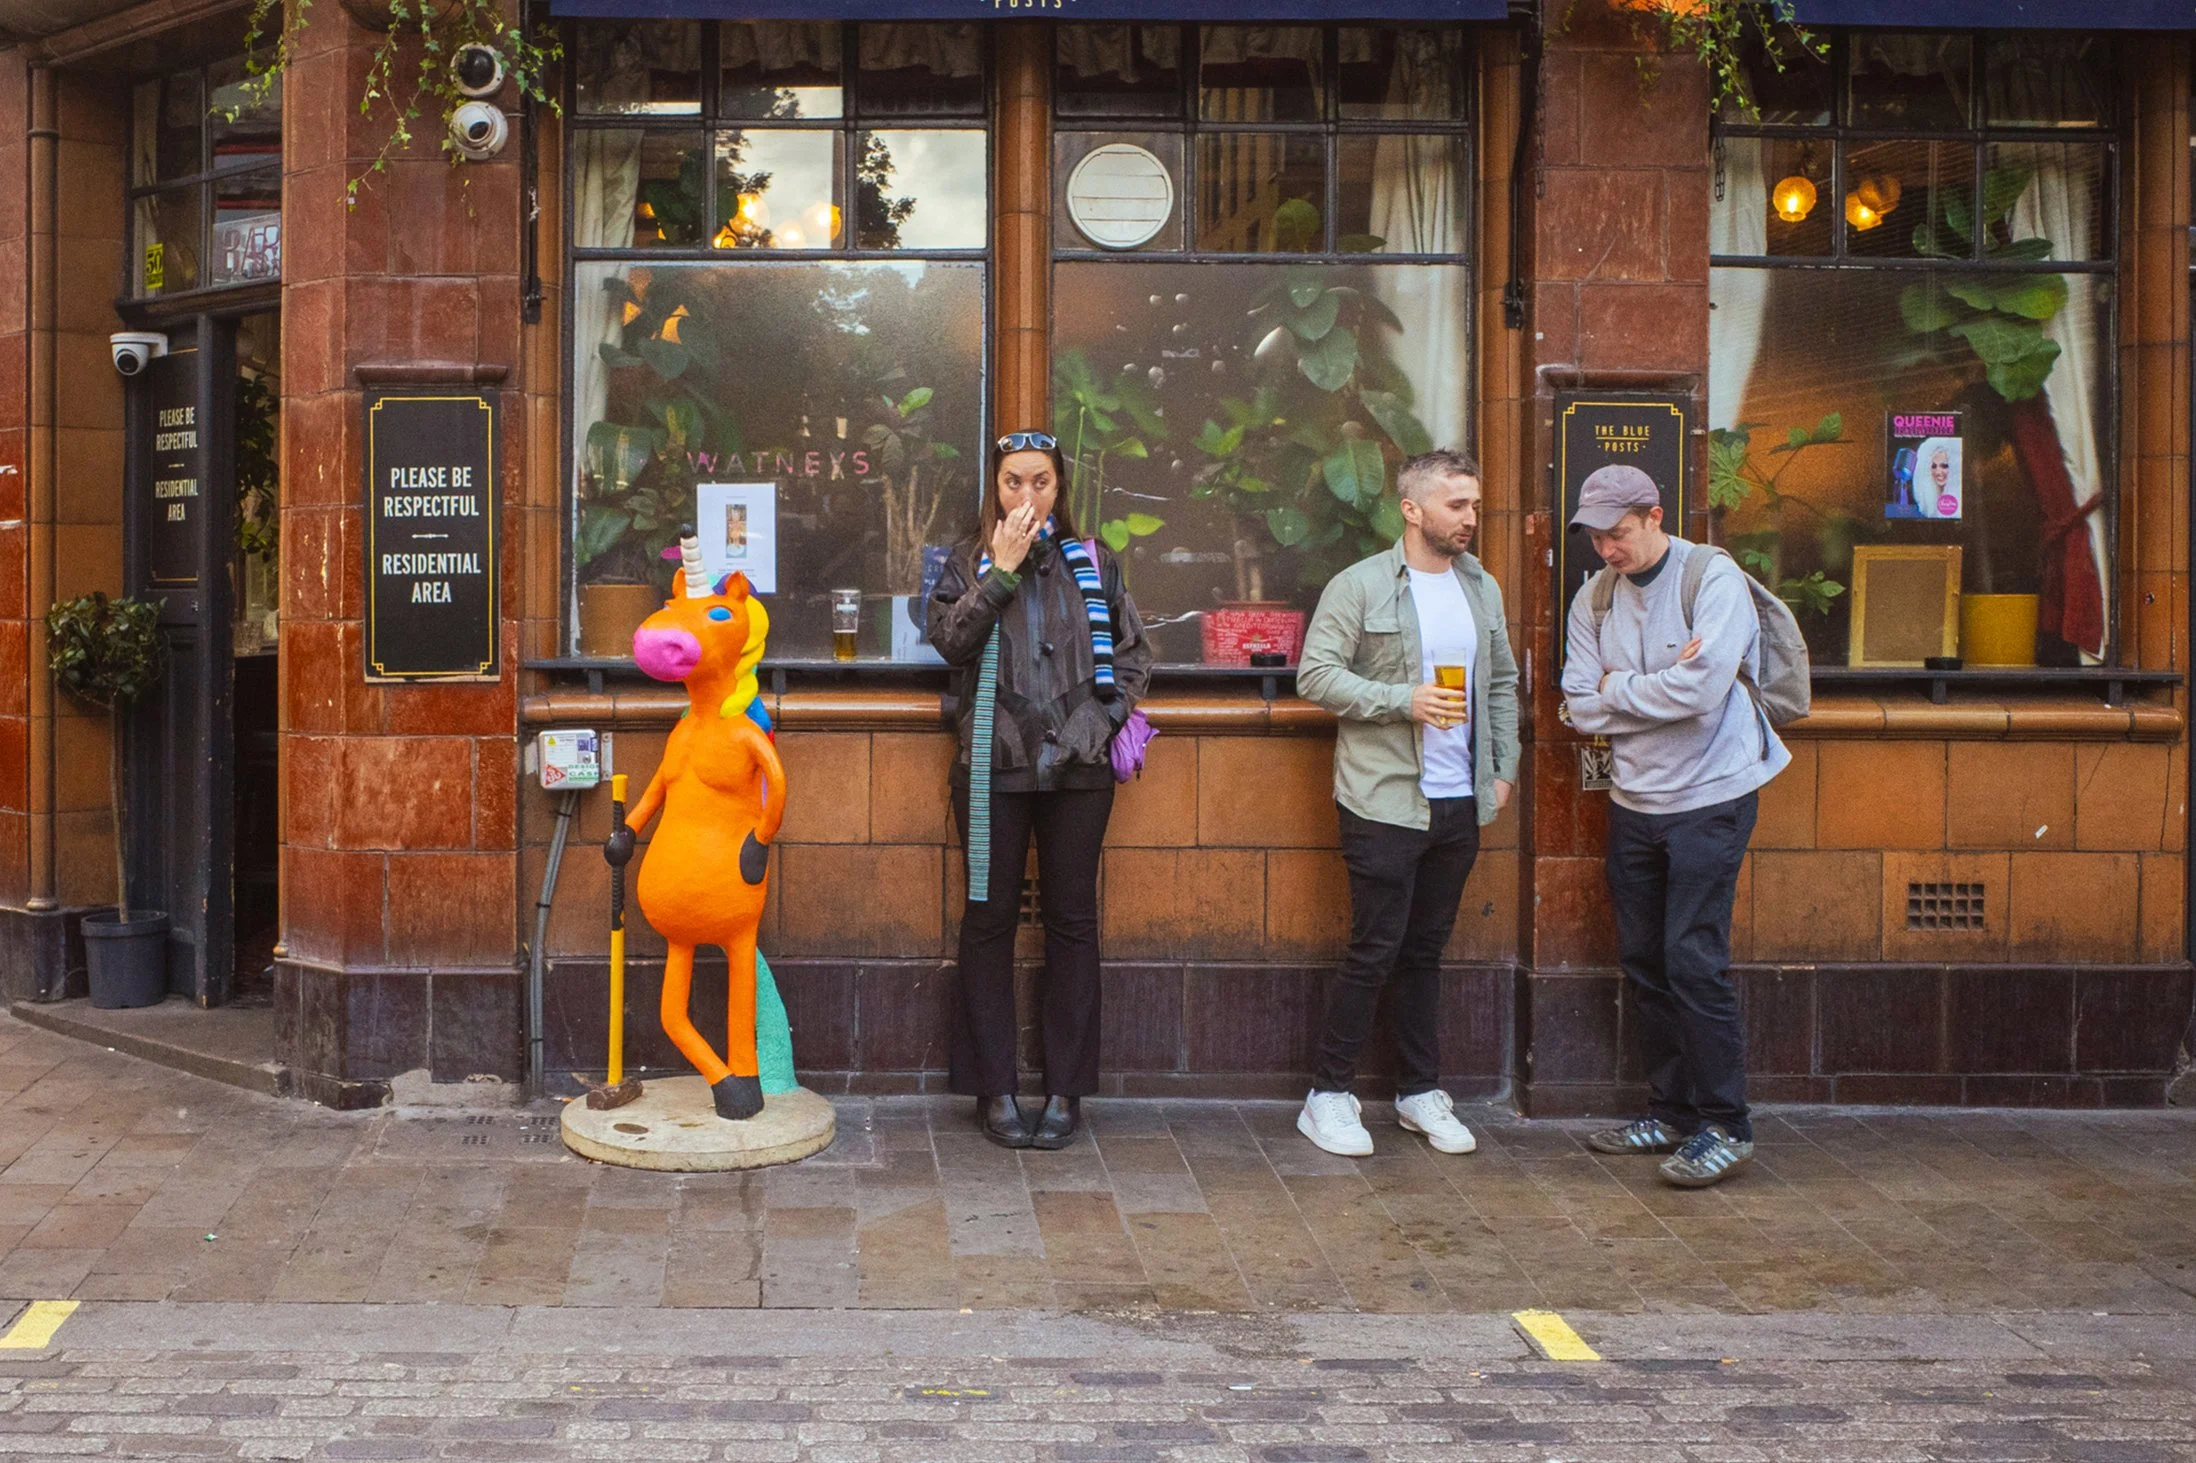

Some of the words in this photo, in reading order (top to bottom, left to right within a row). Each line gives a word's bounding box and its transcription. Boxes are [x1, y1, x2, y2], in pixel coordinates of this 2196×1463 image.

[159, 408, 185, 427] PLEASE
[185, 407, 195, 424] BE
[1893, 415, 1955, 427] QUEENIE
[1595, 425, 1614, 436] THE
[1623, 425, 1650, 436] BLUE
[156, 431, 198, 451] RESPECTFUL
[1604, 442, 1639, 452] POSTS
[687, 451, 870, 475] WATNEYS
[391, 467, 447, 488] PLEASE
[452, 466, 472, 487] BE
[155, 479, 198, 498] RESIDENTIAL
[167, 503, 186, 521] AREA
[384, 495, 479, 517] RESPECTFUL
[382, 553, 481, 575] RESIDENTIAL
[411, 582, 452, 603] AREA
